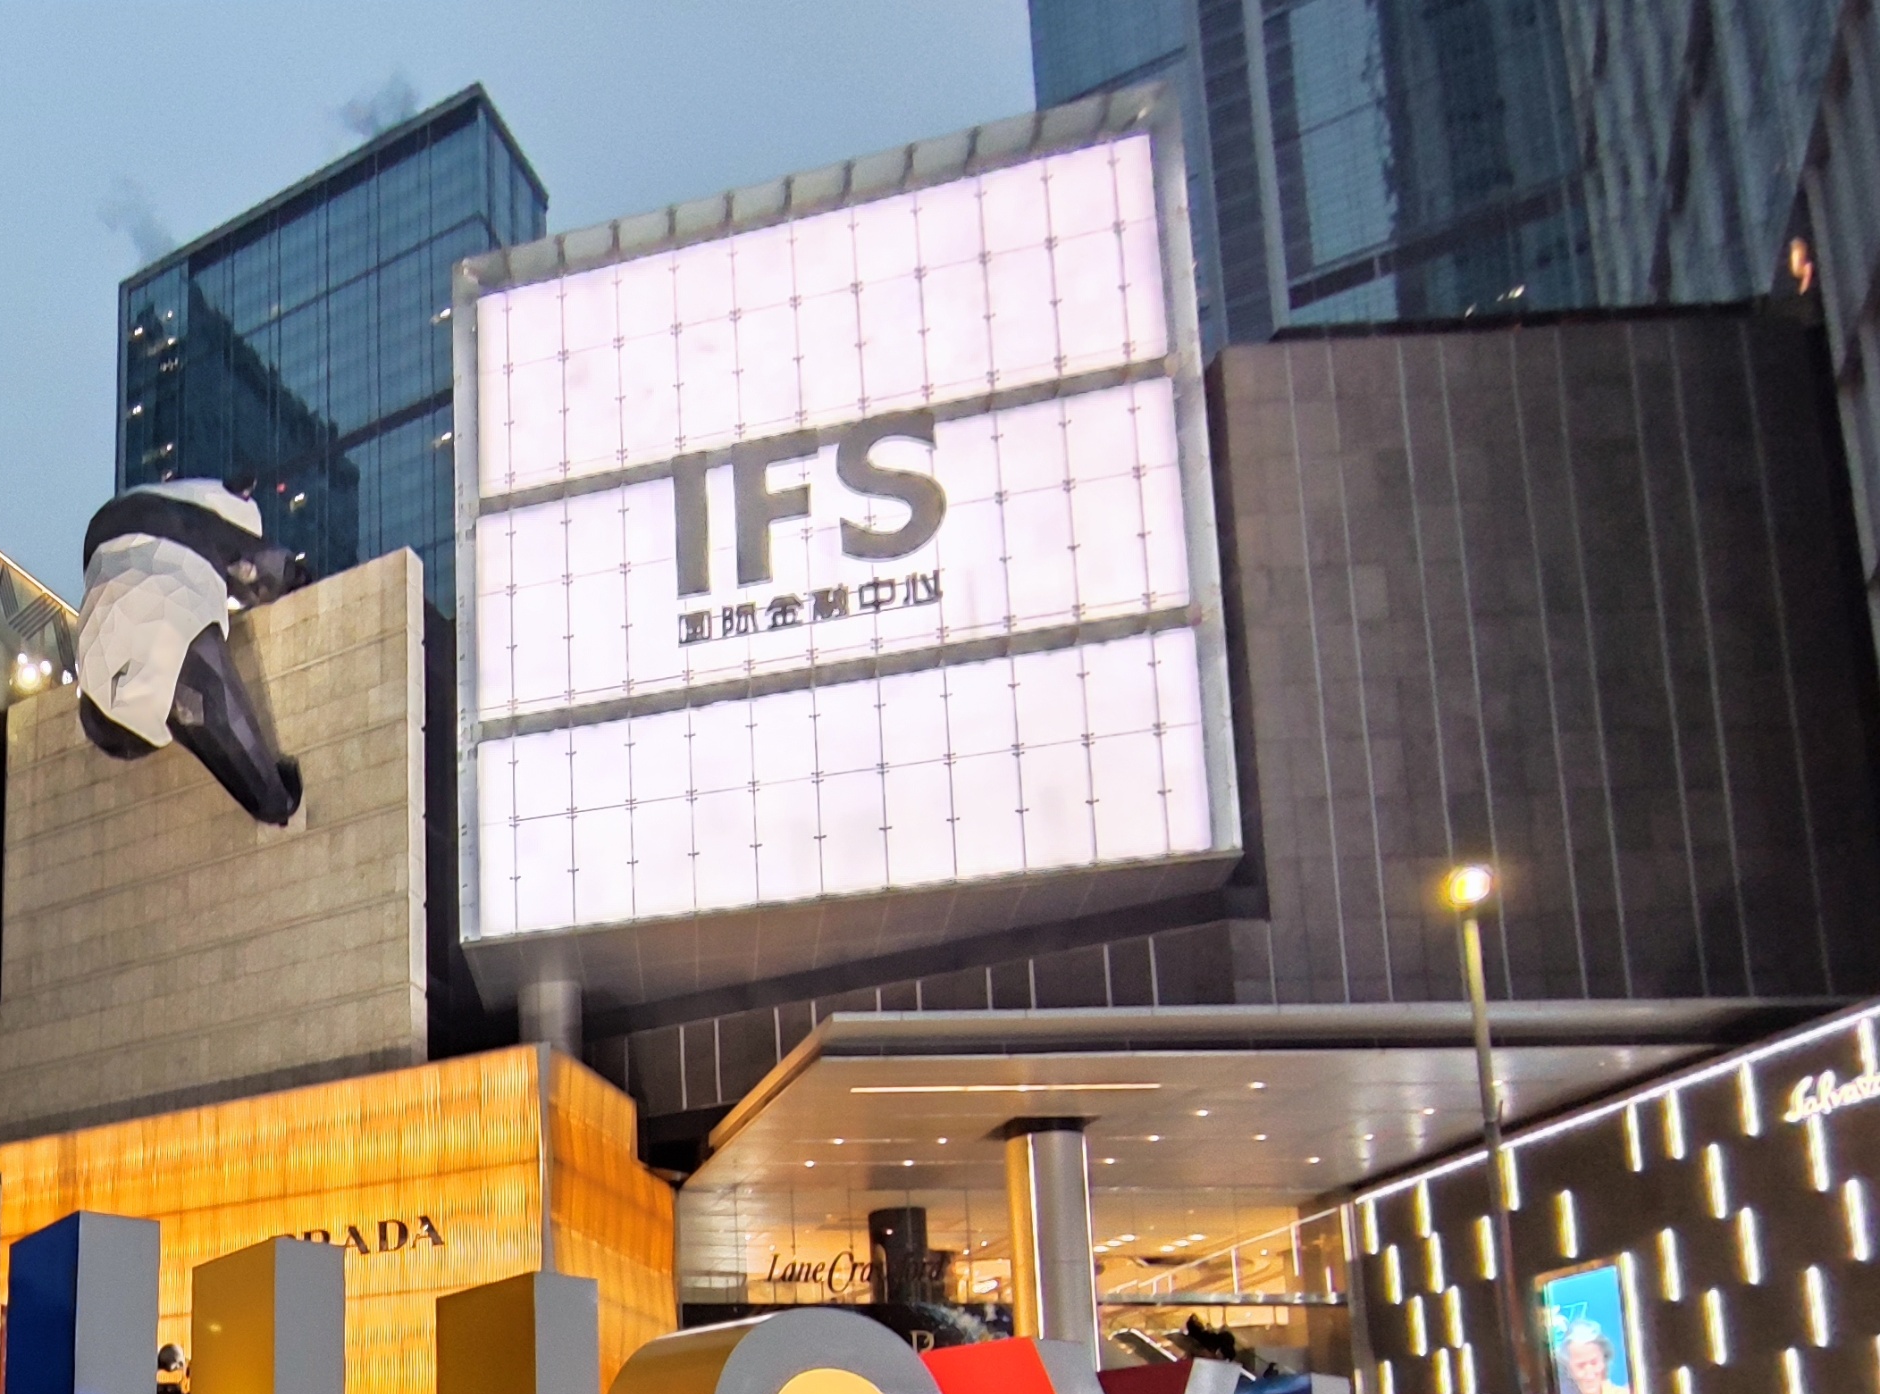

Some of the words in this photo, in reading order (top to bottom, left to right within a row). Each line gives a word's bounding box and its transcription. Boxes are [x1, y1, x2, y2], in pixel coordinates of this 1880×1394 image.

[671, 408, 948, 600] IFS
[278, 1215, 445, 1256] ADA
[766, 1252, 826, 1283] Lane
